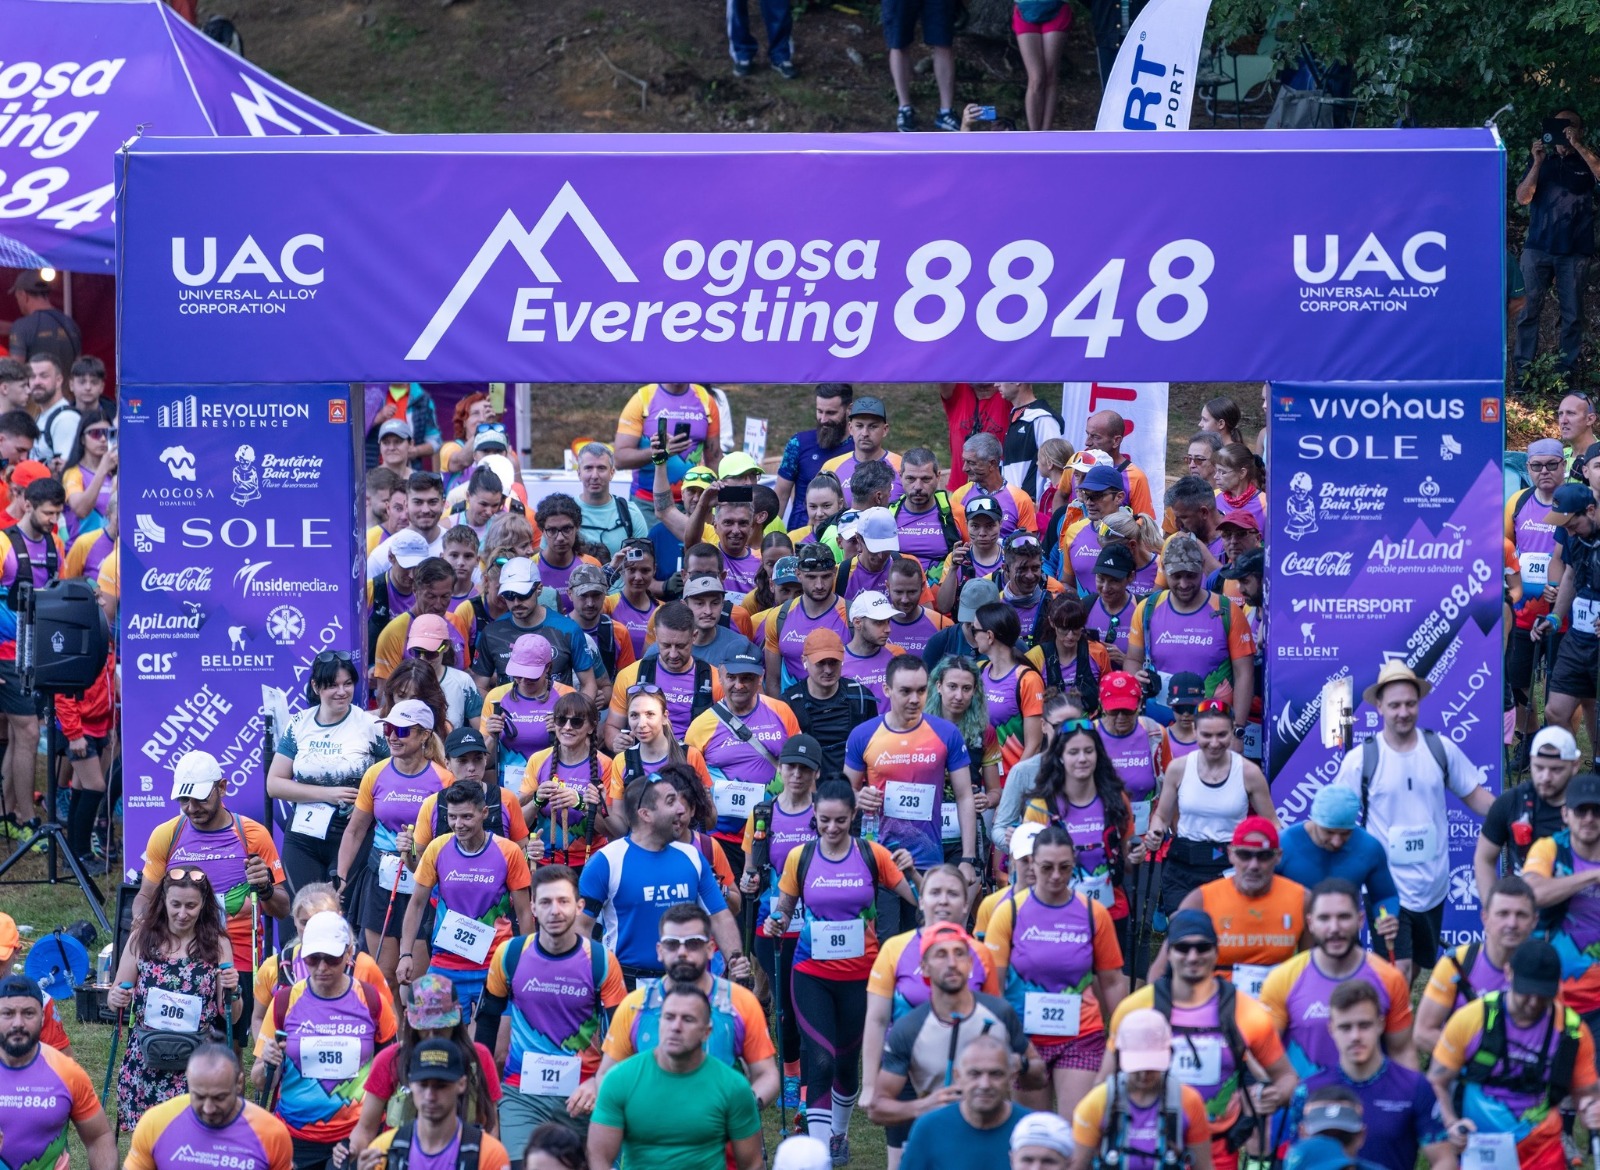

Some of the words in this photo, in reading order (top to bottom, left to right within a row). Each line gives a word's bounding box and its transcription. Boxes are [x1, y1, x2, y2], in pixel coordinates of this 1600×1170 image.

[0, 58, 126, 112] oșa
[0, 166, 115, 230] 84
[172, 233, 324, 286] UAC
[1293, 231, 1446, 284] UAC
[179, 289, 263, 301] UNIVERSAL
[267, 289, 317, 300] ALLOY
[507, 286, 878, 358] Everesting
[893, 239, 1215, 358] 8848
[1300, 286, 1384, 298] UNIVERSAL
[1389, 286, 1439, 298] ALLOY
[179, 303, 286, 314] CORPORATION
[1300, 301, 1407, 312] CORPORATION
[201, 403, 309, 419] REVOLUTION
[1309, 392, 1465, 419] vivohaus
[202, 420, 288, 428] RESIDENCE
[1298, 435, 1418, 459] SOLE
[261, 454, 323, 468] Brutăria
[262, 468, 290, 480] Baia
[290, 468, 321, 482] Sprie
[1319, 482, 1388, 498] Brutăria
[1320, 498, 1351, 510] Baia
[1351, 498, 1385, 513] Sprie
[181, 517, 332, 549] SOLE
[922, 527, 944, 535] 884
[1368, 539, 1463, 568] ApiLand
[1366, 564, 1397, 574] apicole
[1397, 565, 1425, 575] pentru
[1529, 562, 1545, 573] 294
[251, 578, 339, 592] insidemedia.ro
[1308, 599, 1413, 613] INTERSPORT
[1406, 618, 1450, 669] eresting
[1440, 559, 1492, 620] 8848
[128, 613, 200, 634] ApiLand
[127, 632, 151, 640] apicole
[1188, 635, 1213, 646] 8848
[1277, 647, 1339, 657] BELDENT
[137, 653, 173, 673] CIS
[201, 655, 274, 667] BELDENT
[677, 694, 694, 703] 884
[1441, 662, 1493, 727] ALLOY
[141, 705, 194, 764] RUN
[184, 683, 214, 717] for
[188, 692, 233, 743] LIFE
[759, 731, 782, 742] 8848
[912, 753, 936, 763] 8848
[1128, 756, 1149, 766] 8848
[573, 783, 588, 792] 884
[732, 793, 746, 806] 98
[899, 795, 919, 808] 233
[305, 811, 313, 822] 2
[1405, 839, 1424, 852] 379
[474, 874, 495, 883] 8848
[842, 879, 863, 887] 8848
[1086, 889, 1100, 900] 28
[454, 928, 477, 946] 325
[830, 935, 846, 946] 89
[561, 985, 588, 996] 8848
[160, 1004, 184, 1019] 306
[1042, 1008, 1064, 1021] 322
[338, 1023, 366, 1035] 8848
[318, 1051, 343, 1064] 358
[541, 1069, 560, 1082] 121
[24, 1096, 57, 1109] 8848
[220, 1154, 255, 1169] 8848
